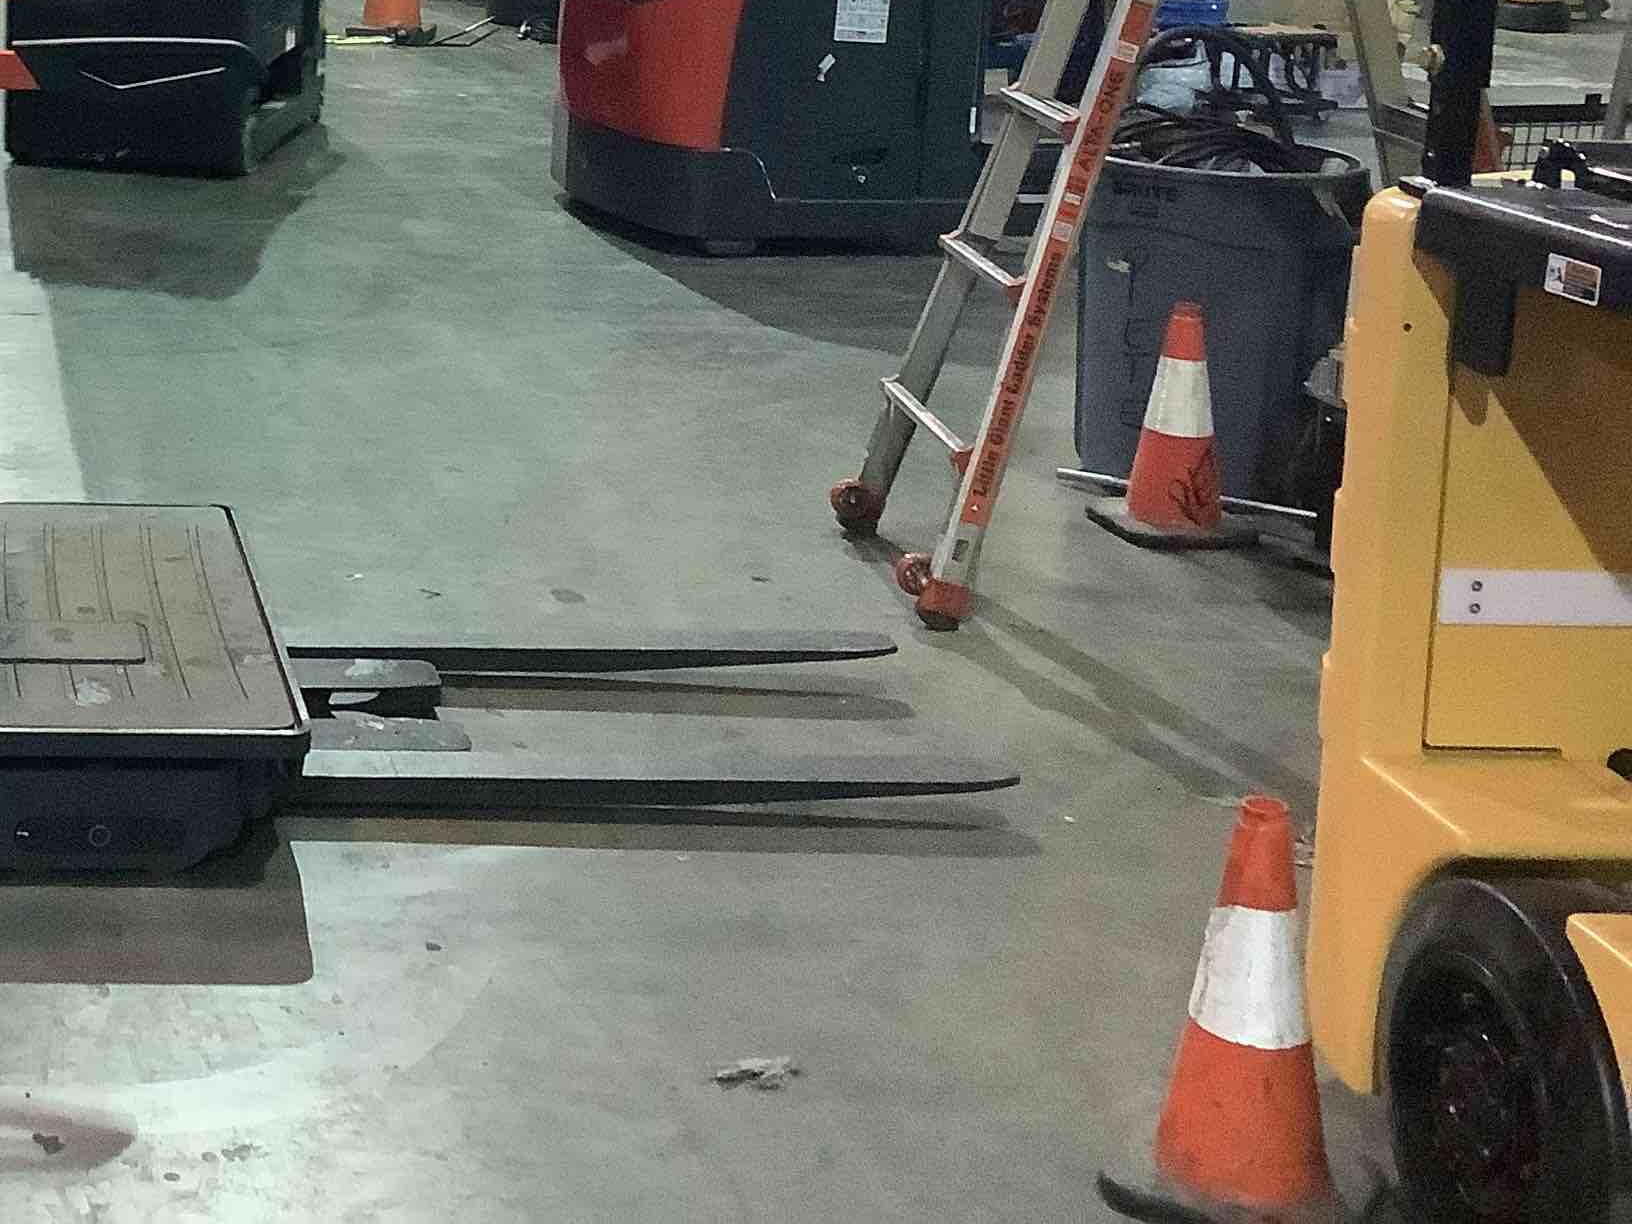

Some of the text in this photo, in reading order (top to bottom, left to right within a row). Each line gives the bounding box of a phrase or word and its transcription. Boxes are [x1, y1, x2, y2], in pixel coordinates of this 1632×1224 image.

[972, 449, 1000, 498] Little
[1005, 333, 1036, 395] Ladder
[1027, 252, 1063, 328] Systems
